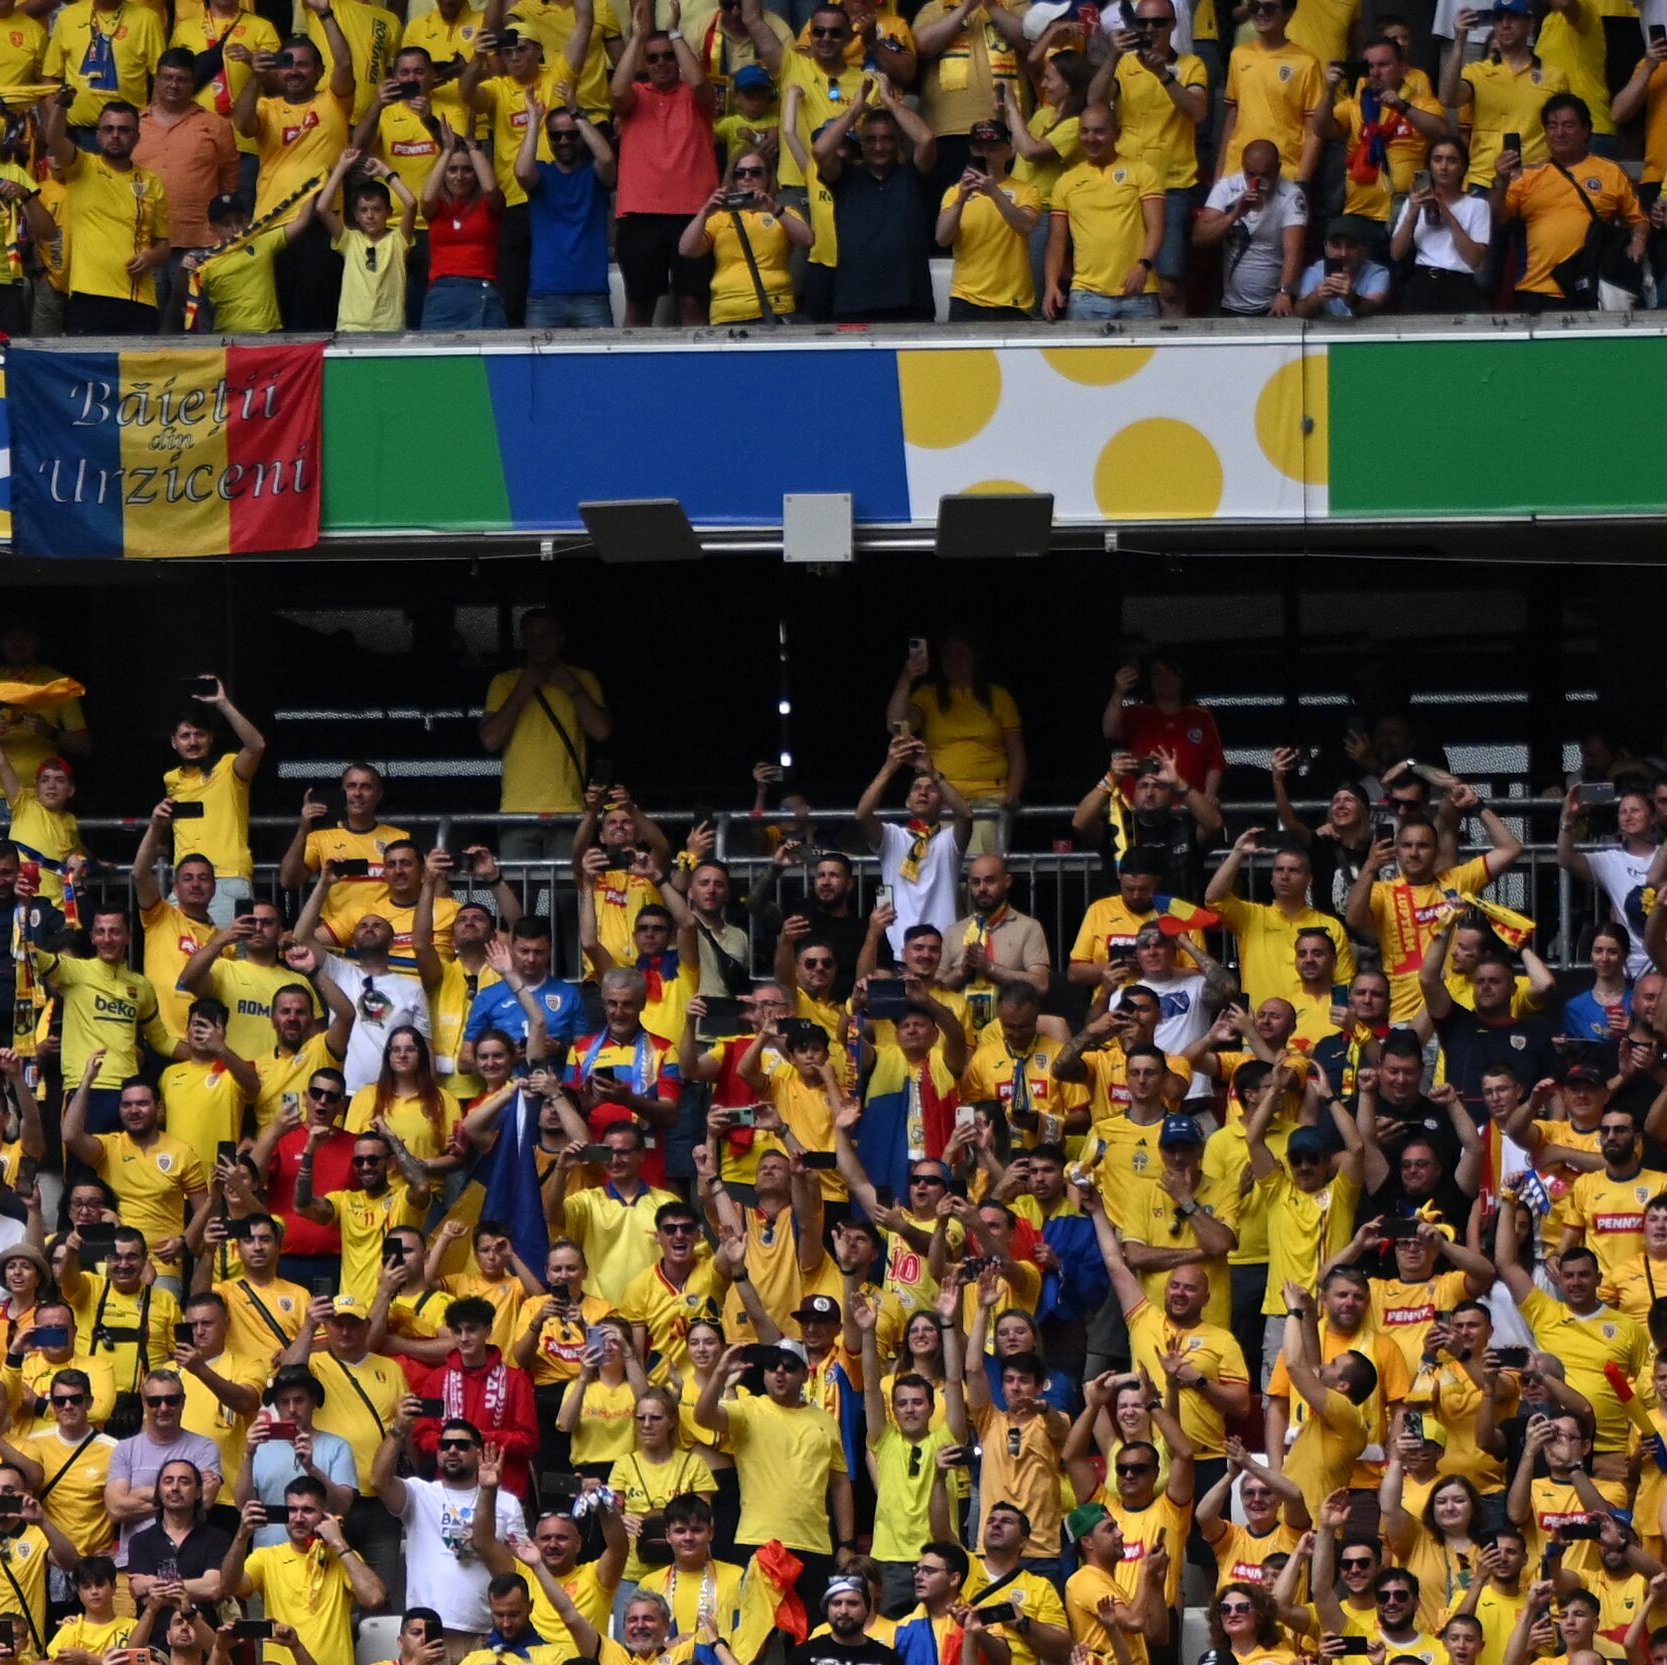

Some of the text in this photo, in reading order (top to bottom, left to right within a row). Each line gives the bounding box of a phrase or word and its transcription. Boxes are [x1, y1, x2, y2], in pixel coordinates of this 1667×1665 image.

[149, 422, 196, 452] din
[38, 447, 309, 507] Urziceni
[94, 994, 137, 1018] beko
[999, 1080, 1043, 1095] PEY.
[886, 1250, 921, 1284] 10
